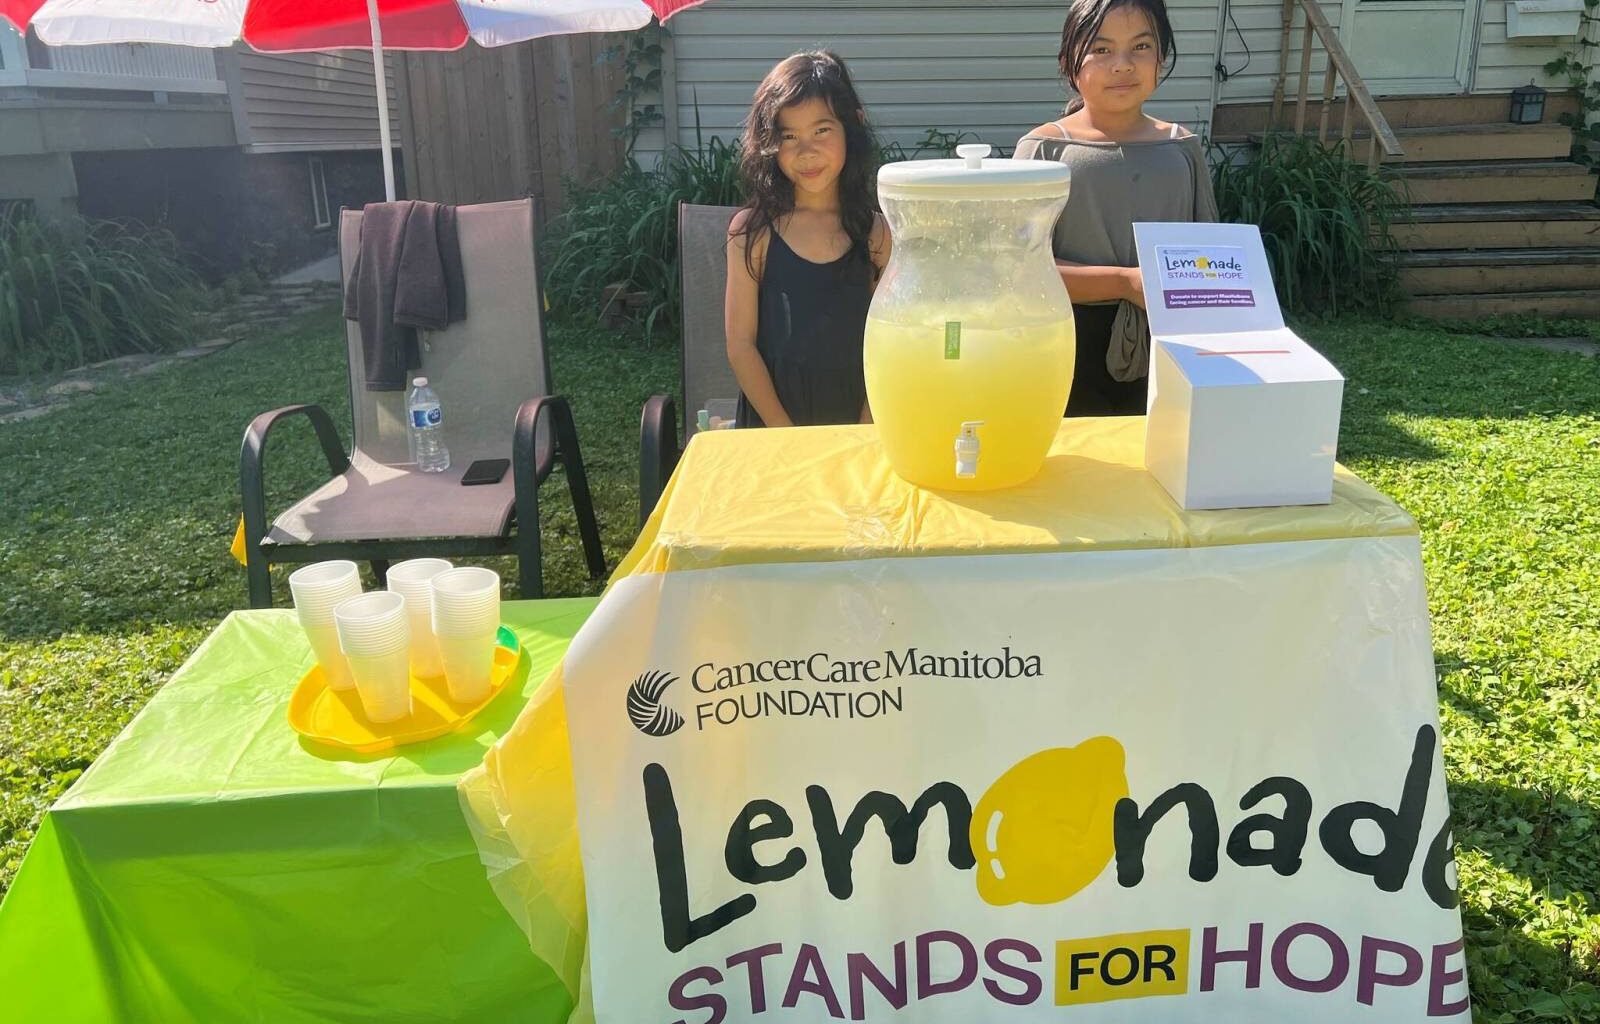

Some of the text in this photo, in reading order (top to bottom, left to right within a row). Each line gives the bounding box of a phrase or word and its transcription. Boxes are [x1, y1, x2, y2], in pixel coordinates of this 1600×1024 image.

[1164, 255, 1242, 271] Lemonade
[1167, 271, 1205, 279] STANDS
[1218, 271, 1244, 279] HOPE
[696, 686, 903, 731] FOUNDATION
[667, 922, 1470, 1024] STANDS FOR HOPE
